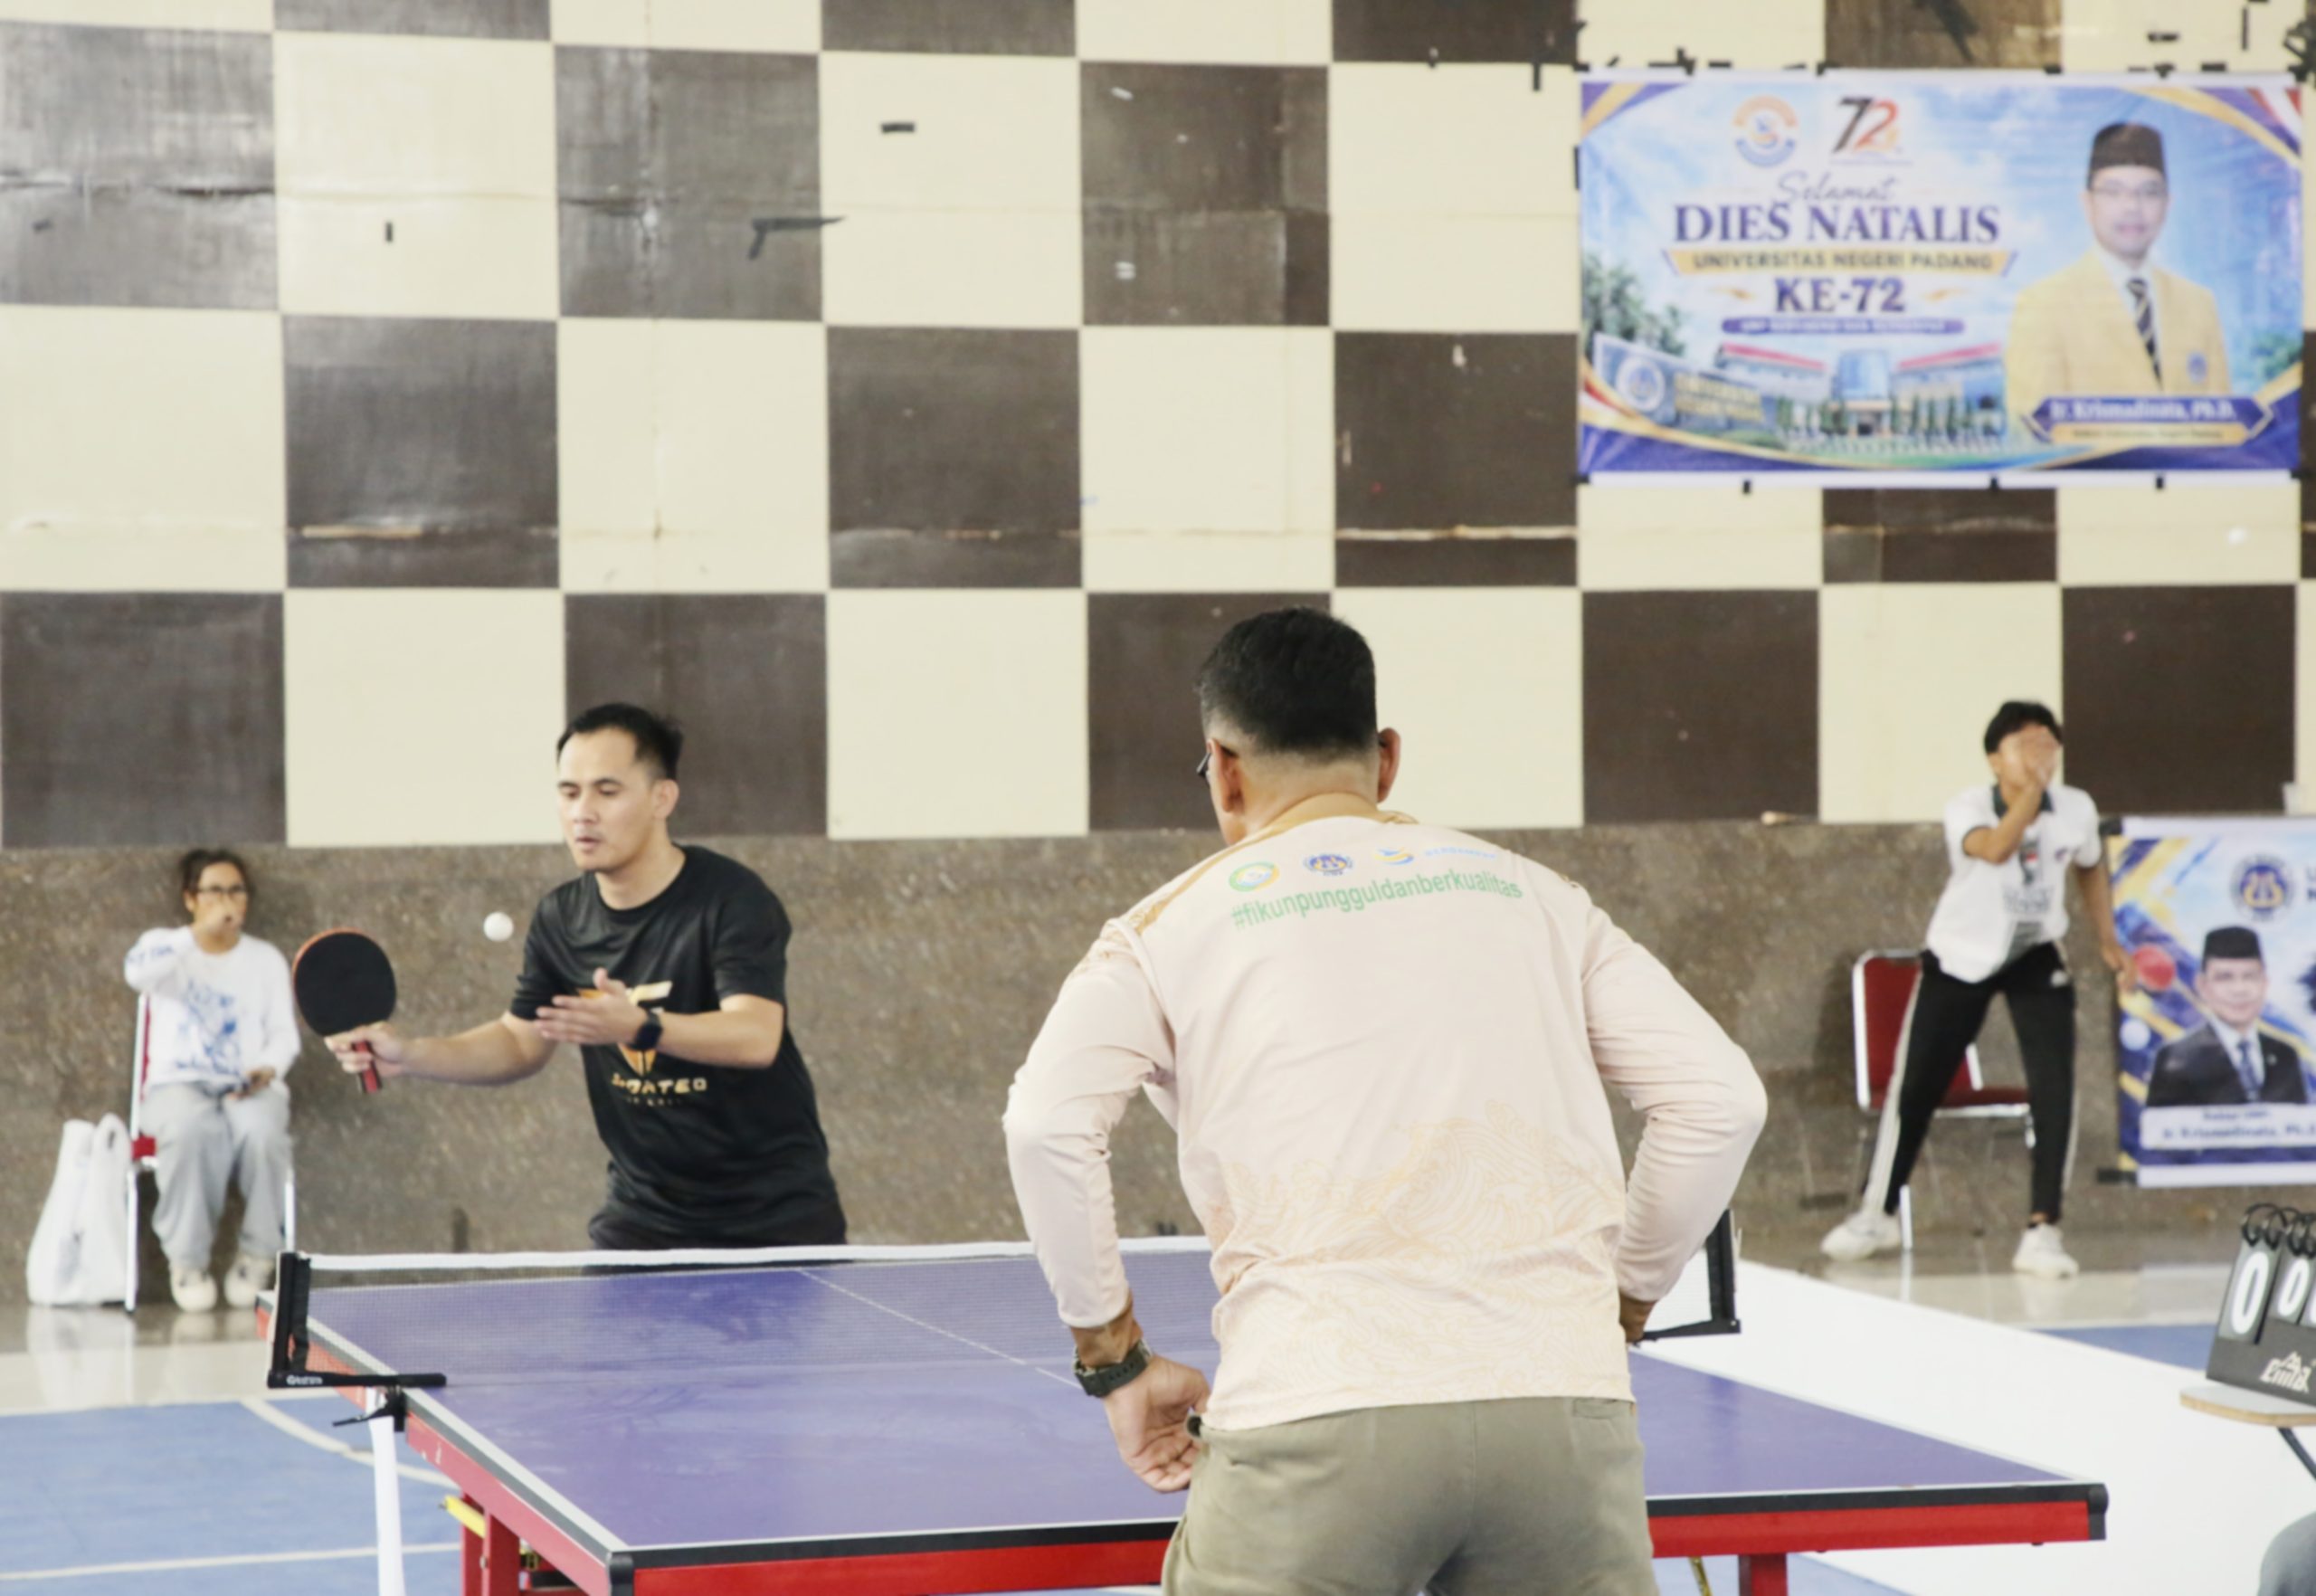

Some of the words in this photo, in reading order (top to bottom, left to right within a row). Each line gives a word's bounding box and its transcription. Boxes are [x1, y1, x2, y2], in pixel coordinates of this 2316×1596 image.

[1832, 95, 1899, 154] 72
[1778, 169, 1897, 203] Selamat
[1674, 204, 1791, 242] DIES
[1809, 204, 2000, 243] NATALIS
[1693, 252, 1825, 269] UNIVERSITAS
[1833, 252, 1905, 269] NEGERI
[1911, 252, 1993, 270] PADANG
[1774, 277, 1906, 313] KE-72
[1230, 869, 1523, 931] #fikunpungguldanberkualitas
[2231, 1251, 2269, 1335] 0
